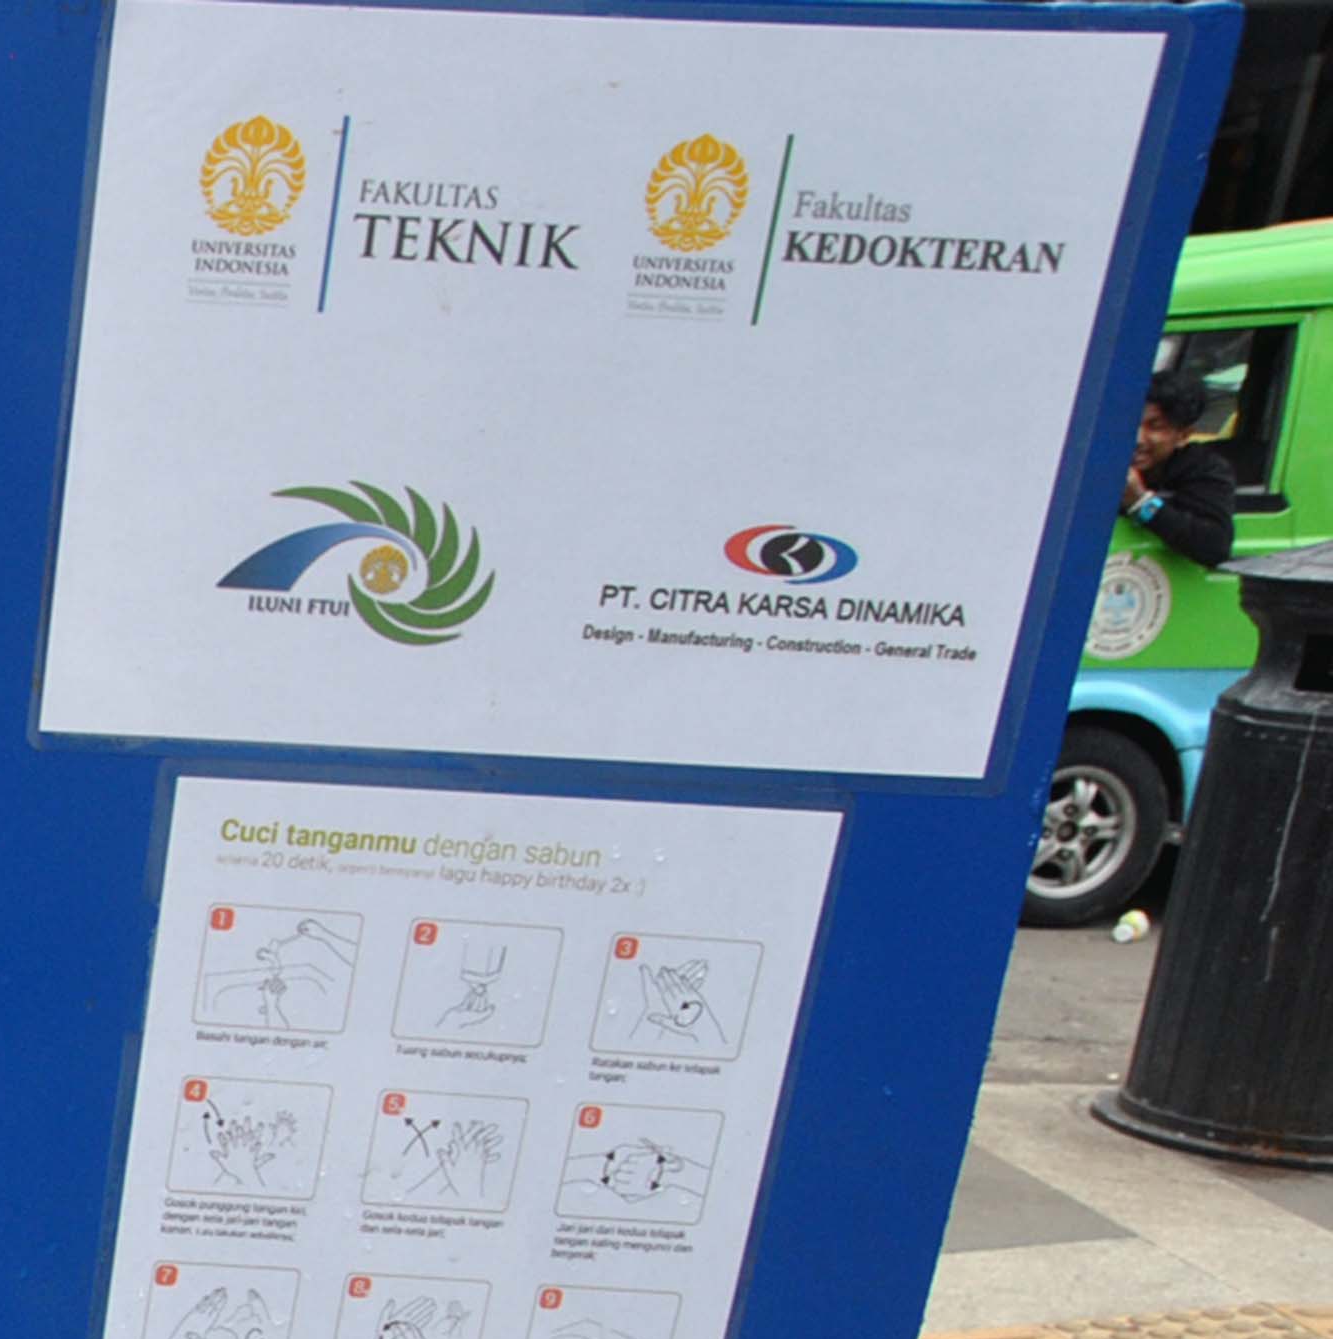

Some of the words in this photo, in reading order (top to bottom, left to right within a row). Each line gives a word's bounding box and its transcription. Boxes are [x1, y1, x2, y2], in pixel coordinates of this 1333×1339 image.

[359, 179, 498, 209] FAKULTAS
[793, 190, 911, 223] Fakultas
[192, 240, 296, 259] UNIVERSITAS
[354, 213, 580, 269] TEKNIK
[783, 232, 1066, 273] KEDOKTERAN
[195, 258, 289, 276] INDONESIA
[633, 255, 734, 275] UNIVERSITAS
[635, 273, 726, 291] INDONESIA
[248, 596, 301, 613] ILUNI
[308, 599, 350, 616] FTUI
[600, 585, 639, 609] PT.
[650, 588, 729, 614] CITRA
[737, 594, 827, 620] KARSA
[837, 599, 965, 626] DINAMIKA
[583, 624, 633, 643] Design
[648, 629, 753, 652] Manufacturing
[767, 636, 860, 656] Construction
[875, 642, 931, 659] General
[936, 645, 976, 661] Trade
[220, 819, 280, 844] Cuci
[286, 827, 418, 855] tanganmu
[423, 834, 516, 864] dengan
[524, 844, 601, 868] sabun
[261, 851, 283, 868] 20
[439, 866, 476, 885] lagu
[479, 868, 533, 889] happy
[536, 872, 606, 894] birthday
